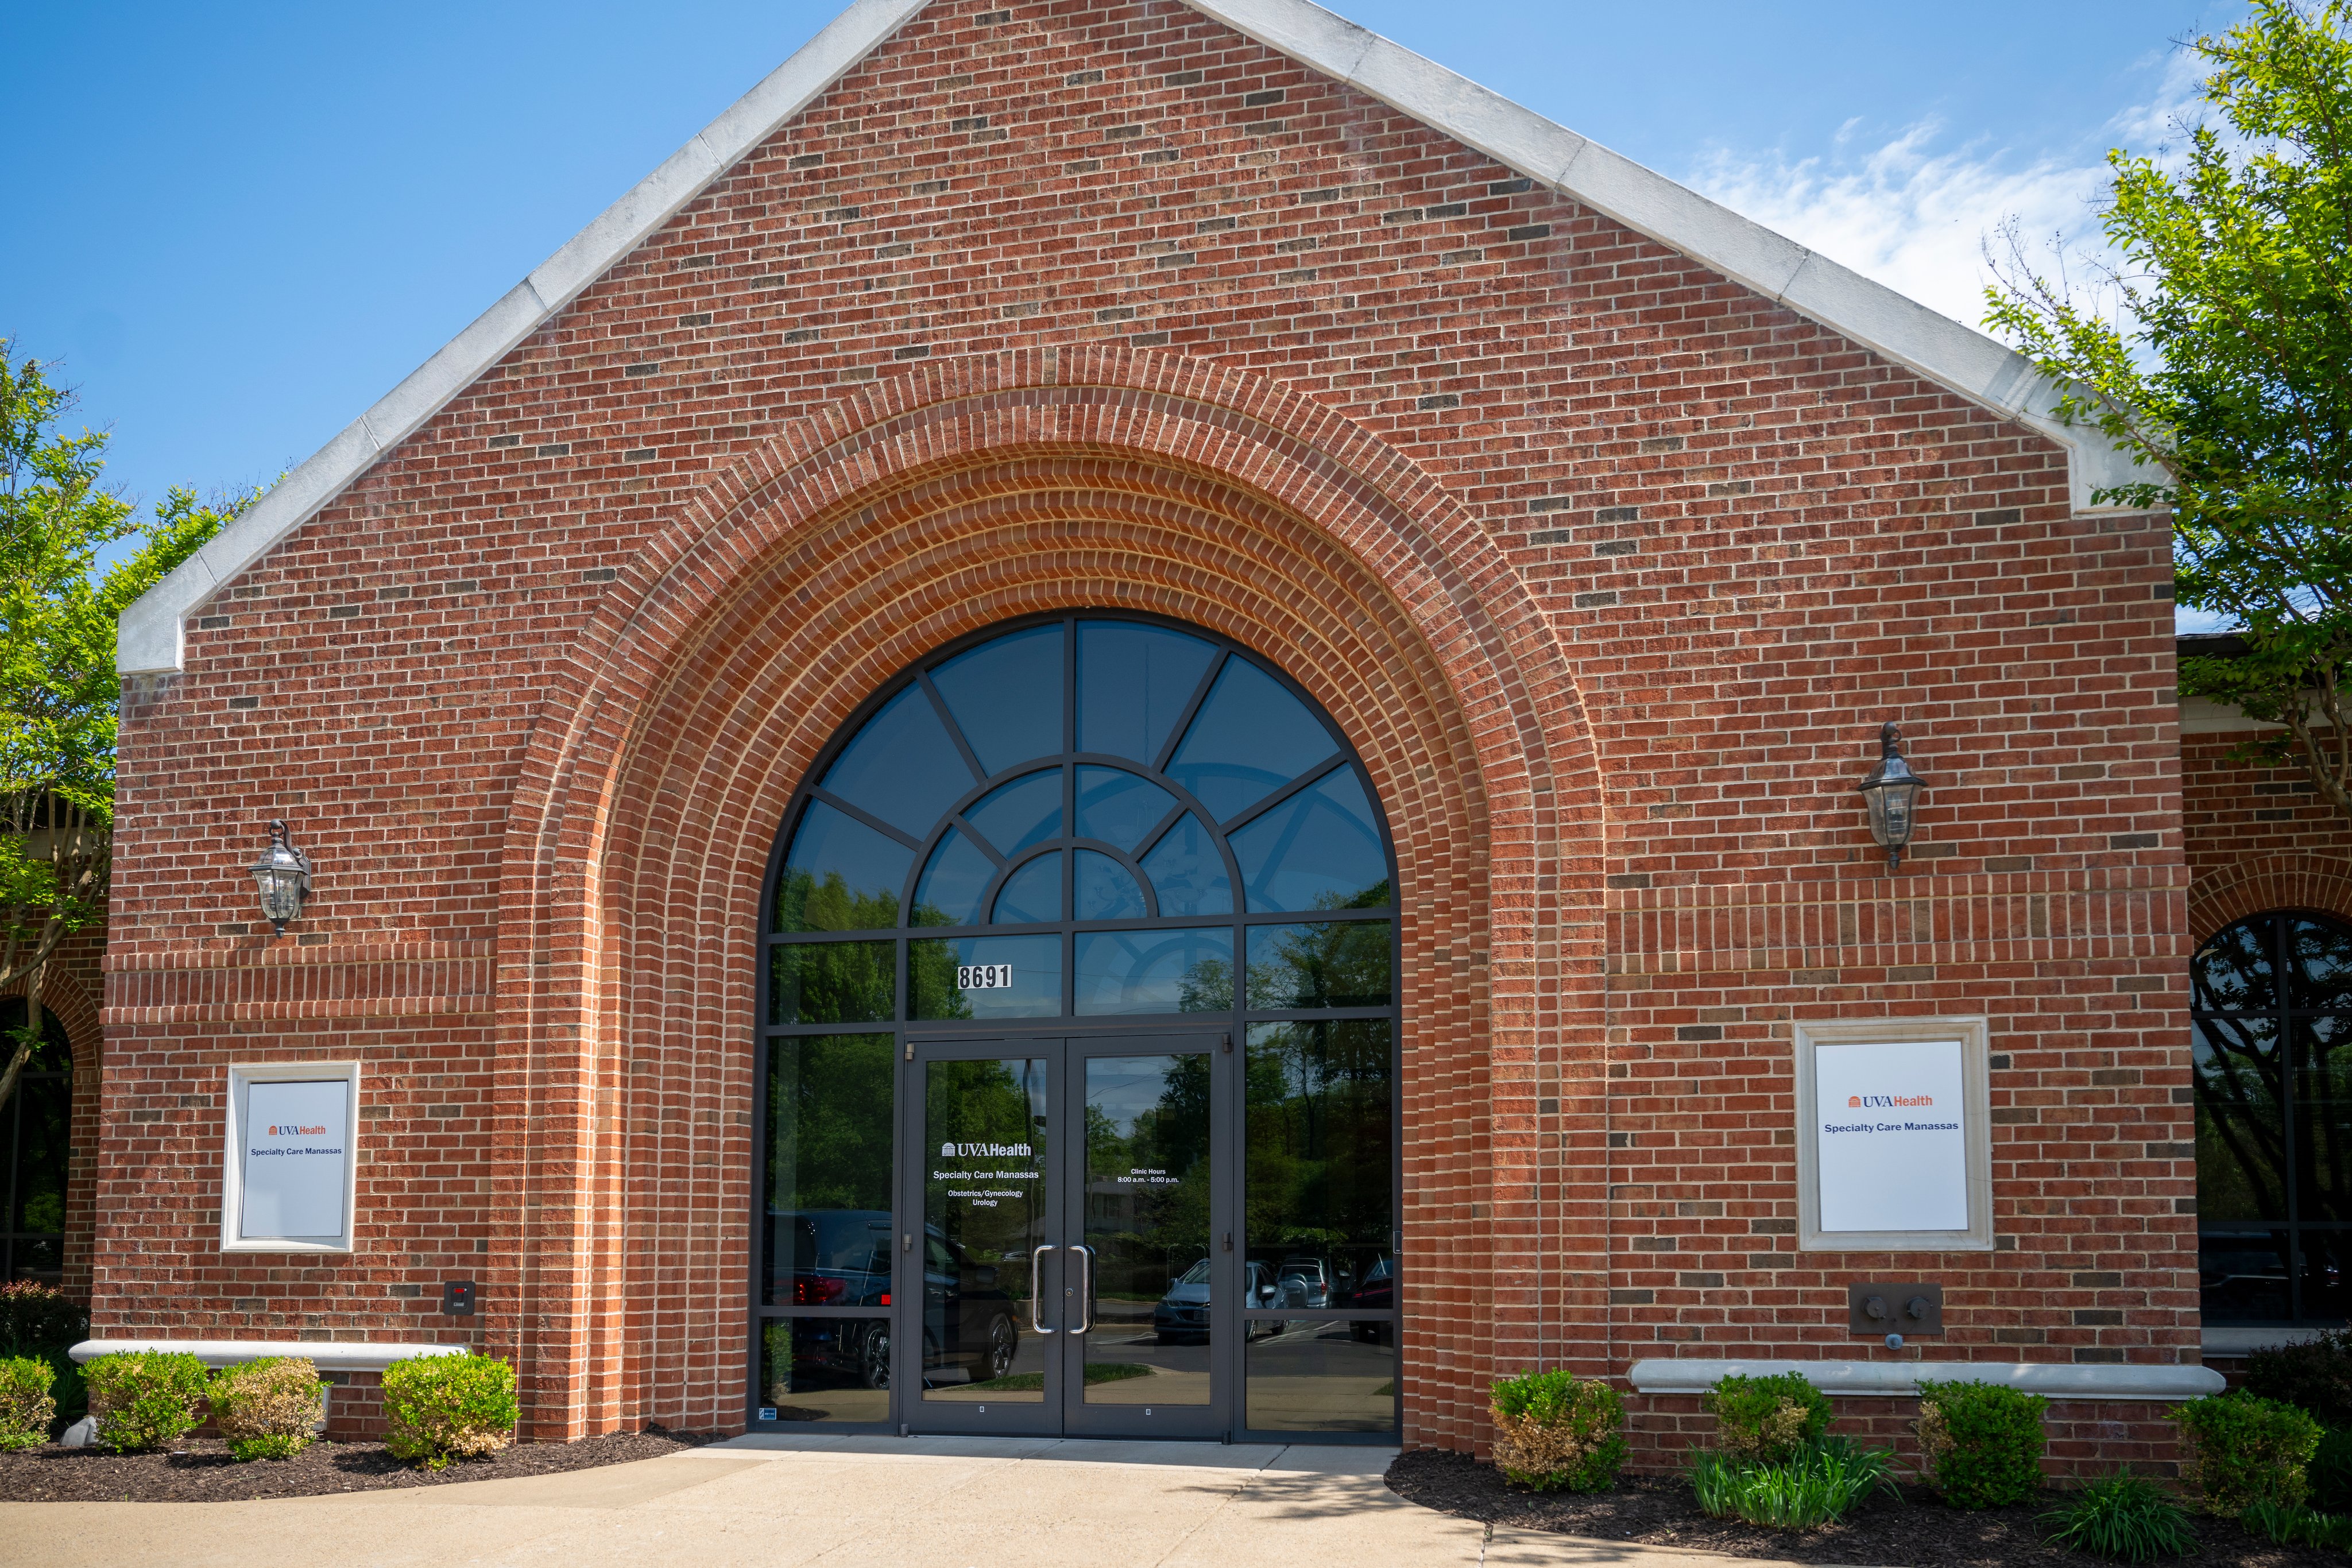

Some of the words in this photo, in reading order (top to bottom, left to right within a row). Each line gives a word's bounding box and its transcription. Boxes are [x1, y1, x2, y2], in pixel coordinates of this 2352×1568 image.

[960, 965, 1008, 989] 8691
[1824, 1124, 1874, 1134] Specialty
[1877, 1123, 1902, 1132] Care
[1904, 1122, 1959, 1130] Manassas
[251, 1148, 285, 1157] Specialty
[933, 1171, 972, 1180] Specialty
[974, 1171, 993, 1179] Care
[996, 1171, 1039, 1179] Manassas
[947, 1190, 1023, 1198] Obstetrics/Gynecology
